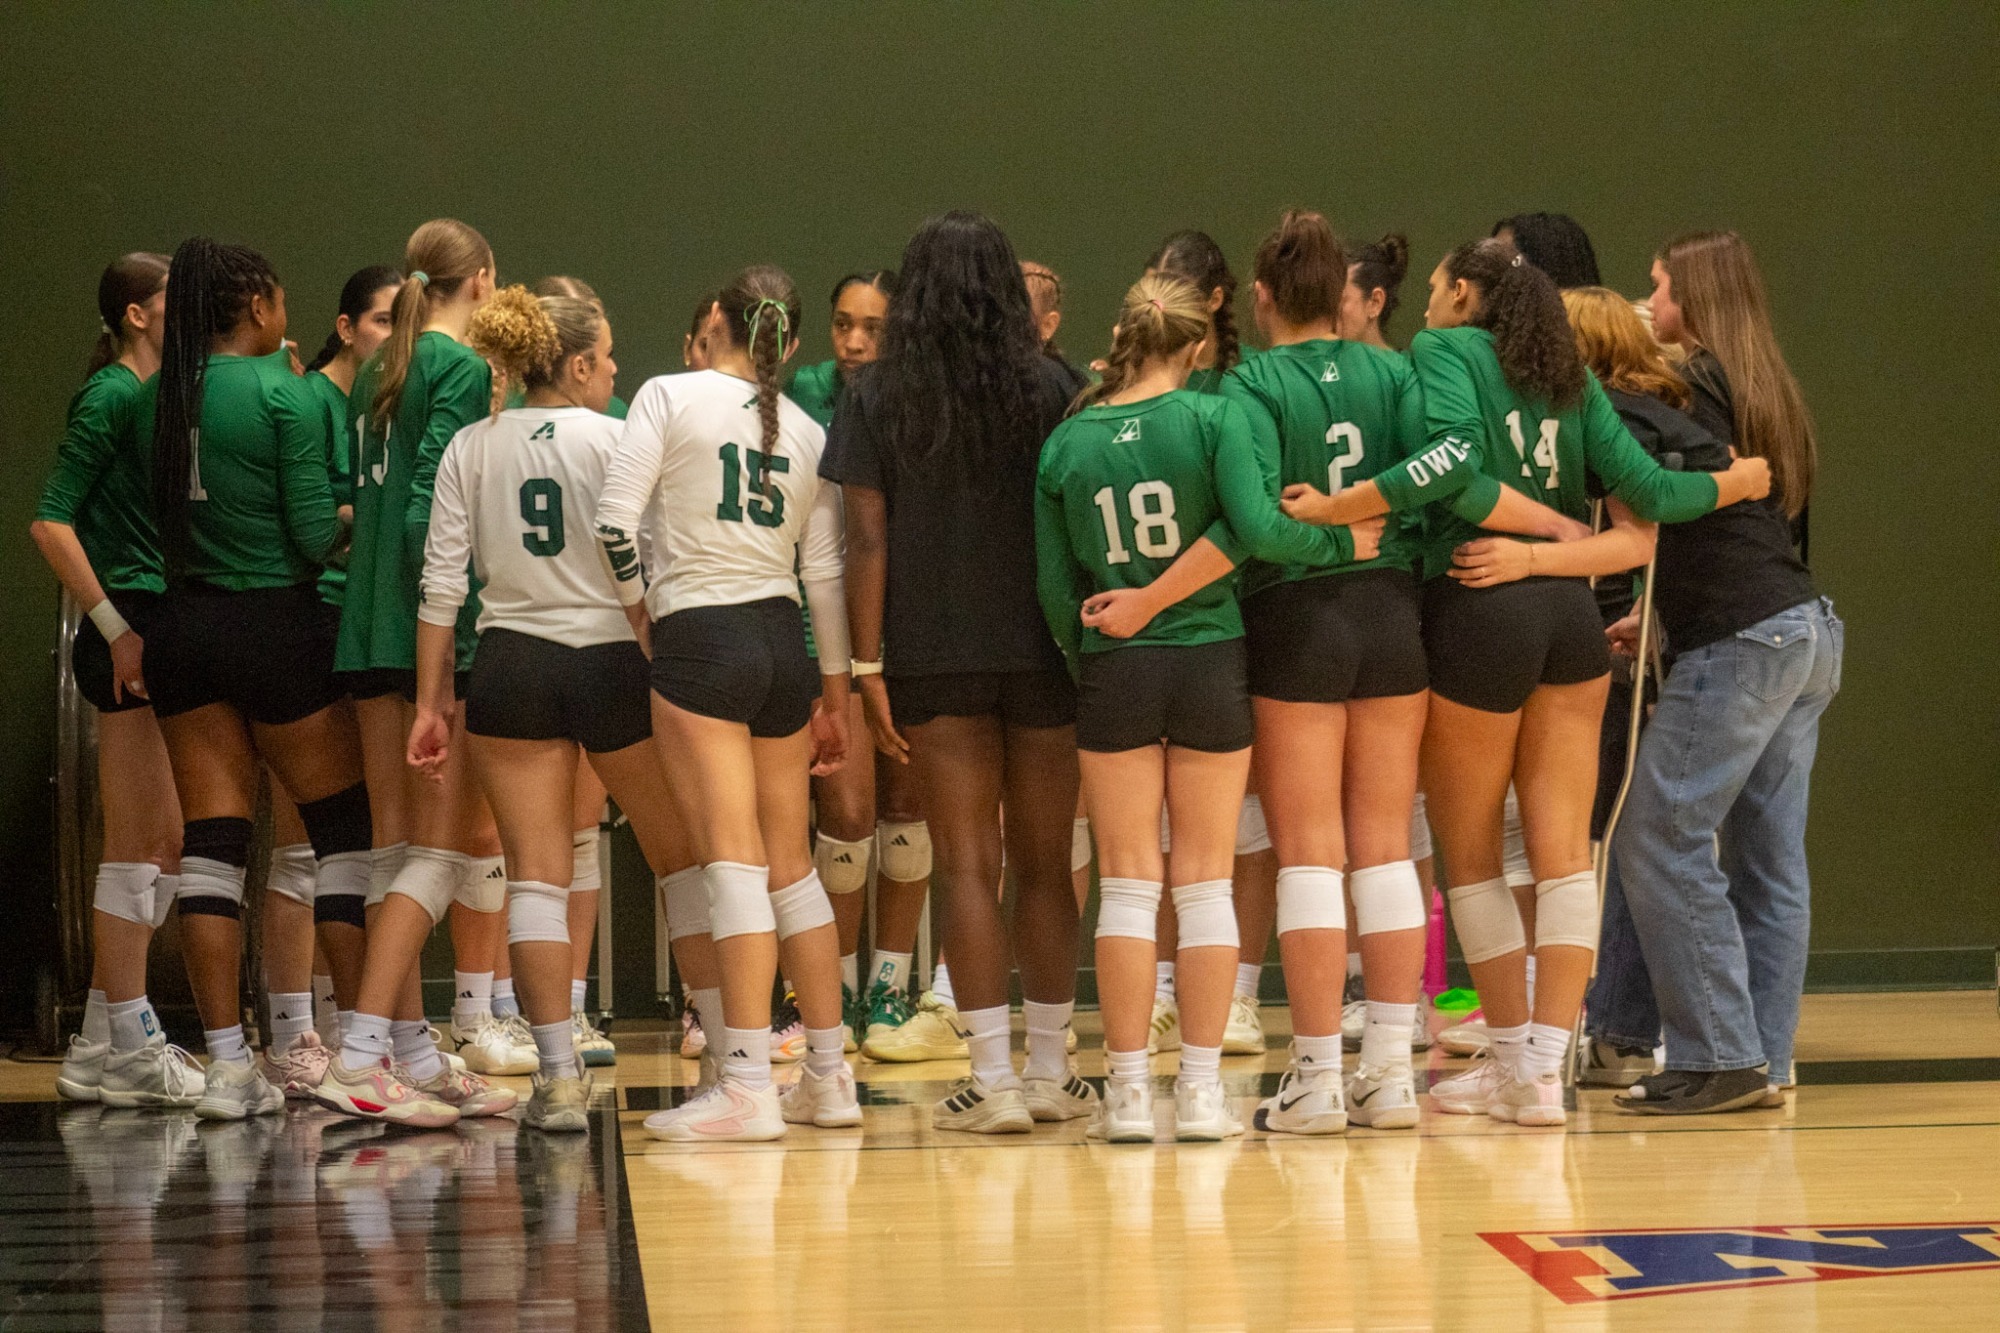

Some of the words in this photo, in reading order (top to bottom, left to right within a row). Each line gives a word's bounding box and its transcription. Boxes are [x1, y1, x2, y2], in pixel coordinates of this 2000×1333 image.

[717, 442, 790, 528] 15
[1325, 421, 1366, 496] 2
[1505, 410, 1560, 490] 14
[519, 478, 566, 557] 9
[1094, 480, 1181, 565] 18
